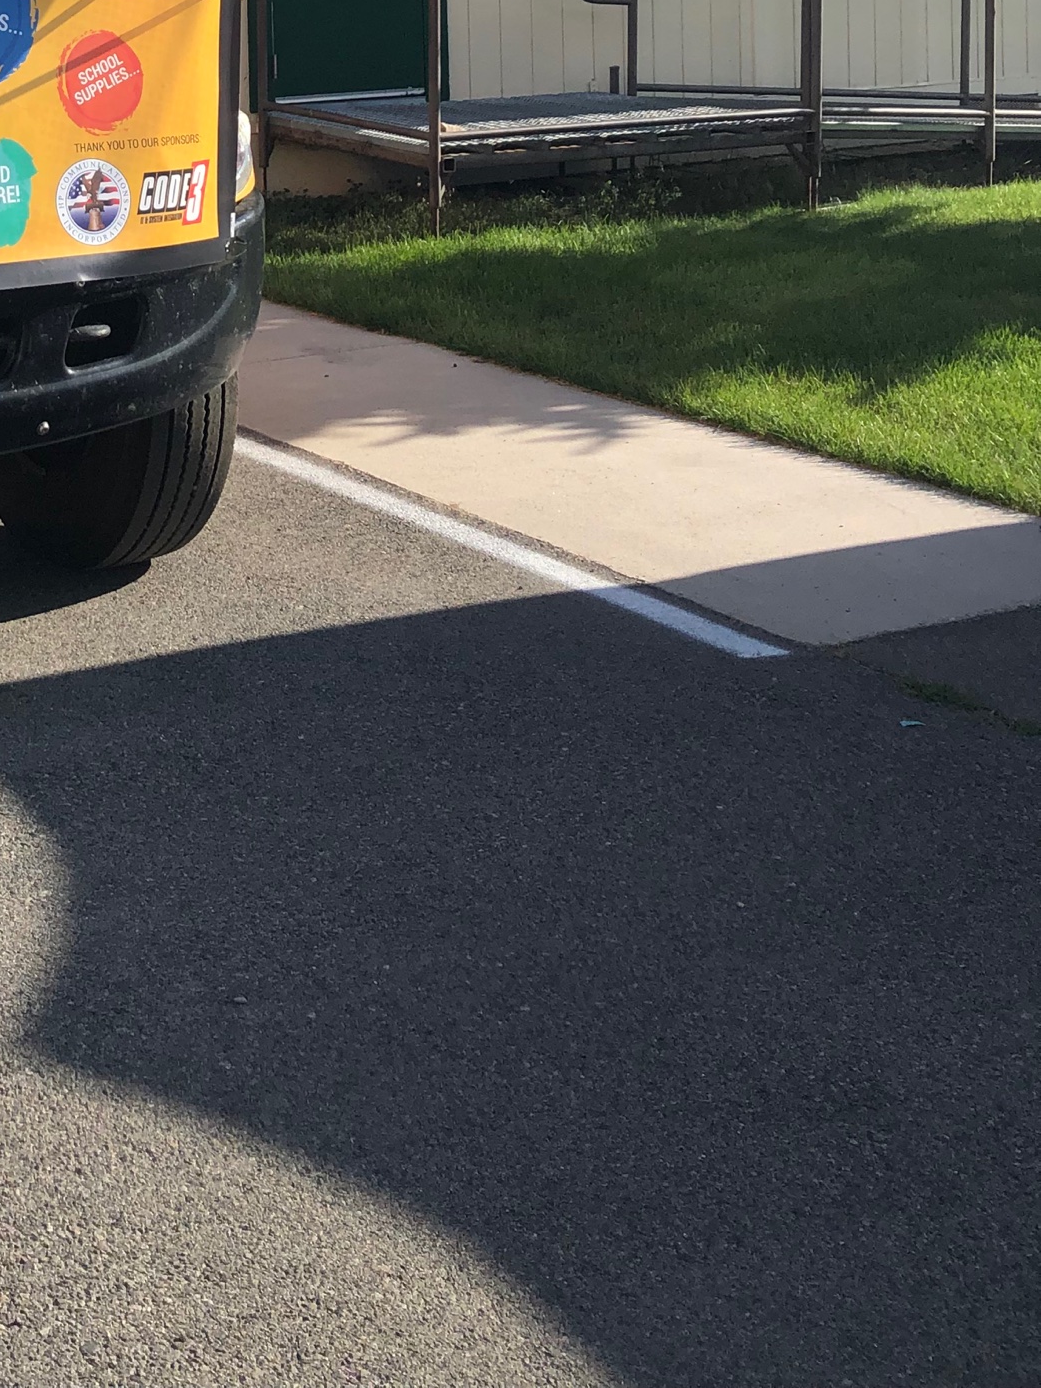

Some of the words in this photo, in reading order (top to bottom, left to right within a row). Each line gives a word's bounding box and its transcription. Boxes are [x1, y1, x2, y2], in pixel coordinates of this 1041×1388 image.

[77, 53, 124, 85] SCHOOL
[74, 141, 106, 153] THANK
[107, 140, 126, 151] YOU
[127, 138, 139, 149] TO
[141, 136, 159, 148] OUR
